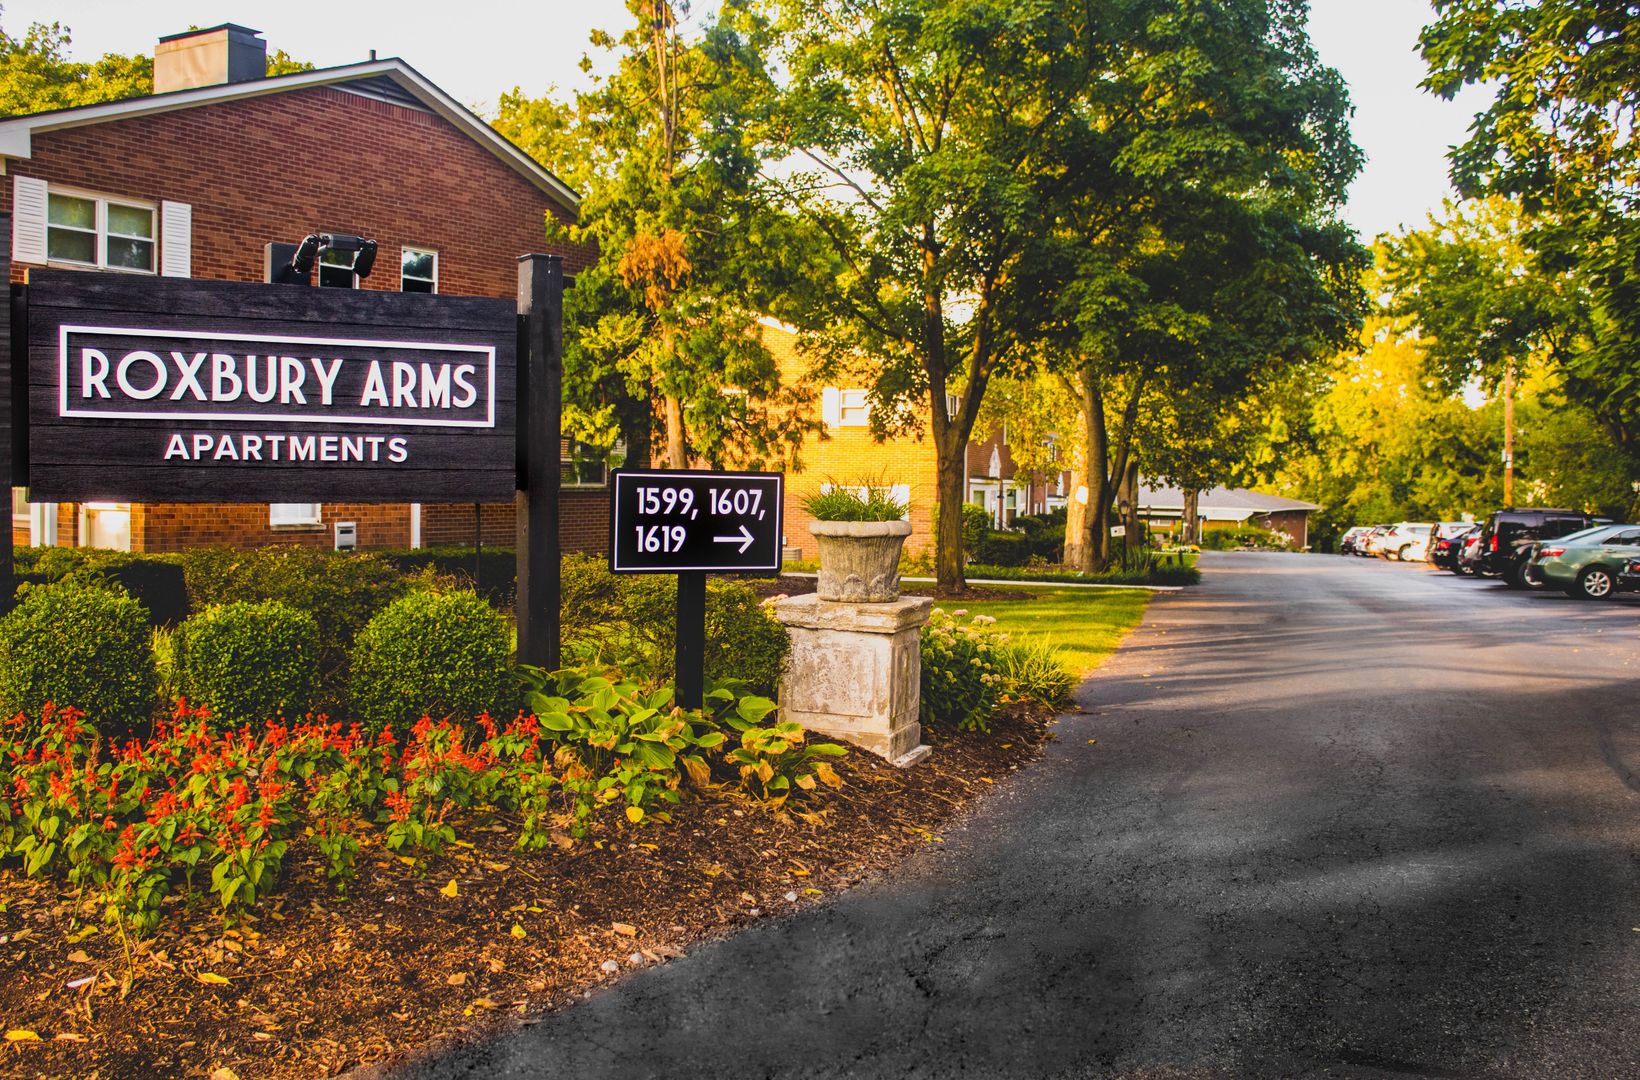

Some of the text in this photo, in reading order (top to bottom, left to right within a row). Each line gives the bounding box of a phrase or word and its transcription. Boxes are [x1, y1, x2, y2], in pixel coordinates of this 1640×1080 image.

[81, 348, 477, 408] ROXBURY ARMS
[164, 433, 408, 463] APARTMENTS
[636, 487, 766, 521] 1599, 1607,
[635, 525, 686, 553] 1619
